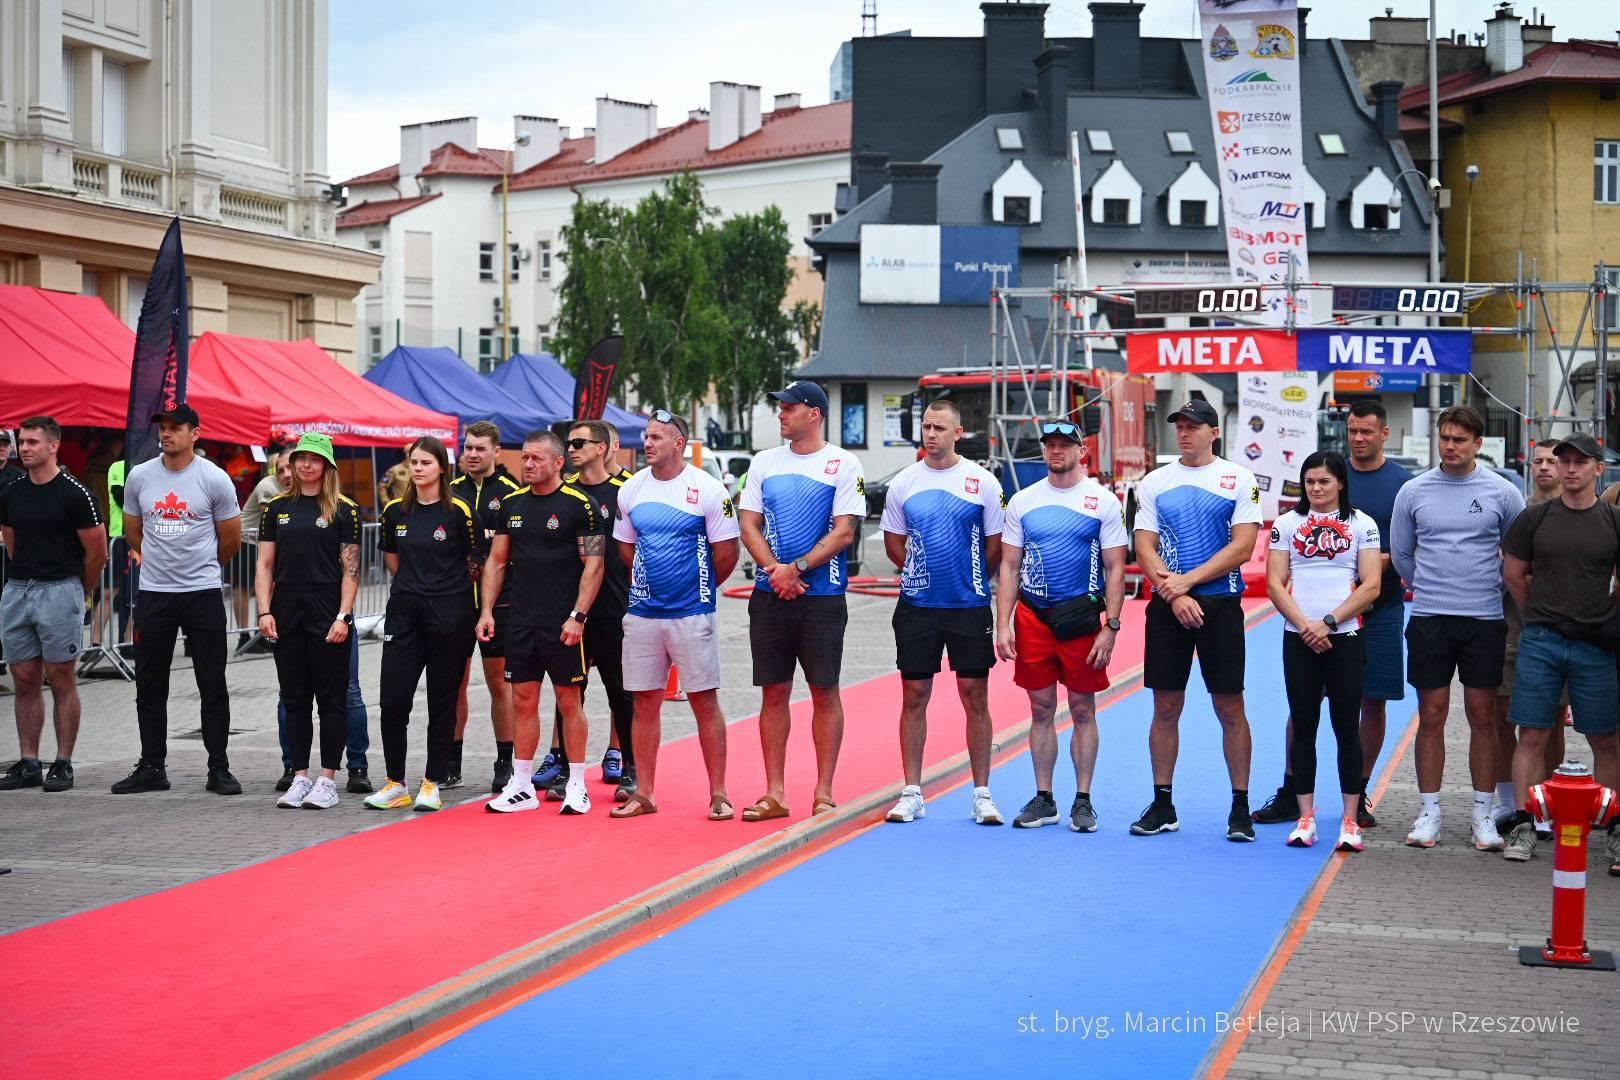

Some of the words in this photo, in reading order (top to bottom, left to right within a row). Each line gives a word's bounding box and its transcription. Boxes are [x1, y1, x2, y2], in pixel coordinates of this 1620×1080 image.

[1214, 83, 1292, 95] PODKARPACKIE
[1242, 111, 1291, 122] rzeszów
[1243, 146, 1292, 156] TEXOM
[1240, 171, 1292, 181] METKOM
[954, 262, 979, 272] Punkt
[1198, 288, 1258, 312] 0.00
[1397, 288, 1460, 313] 0.00
[1158, 336, 1263, 366] META
[1328, 335, 1437, 366] META
[697, 534, 711, 603] POMORSKIE
[971, 524, 986, 596] POMORSKIE
[1088, 538, 1100, 597] MORSKIE
